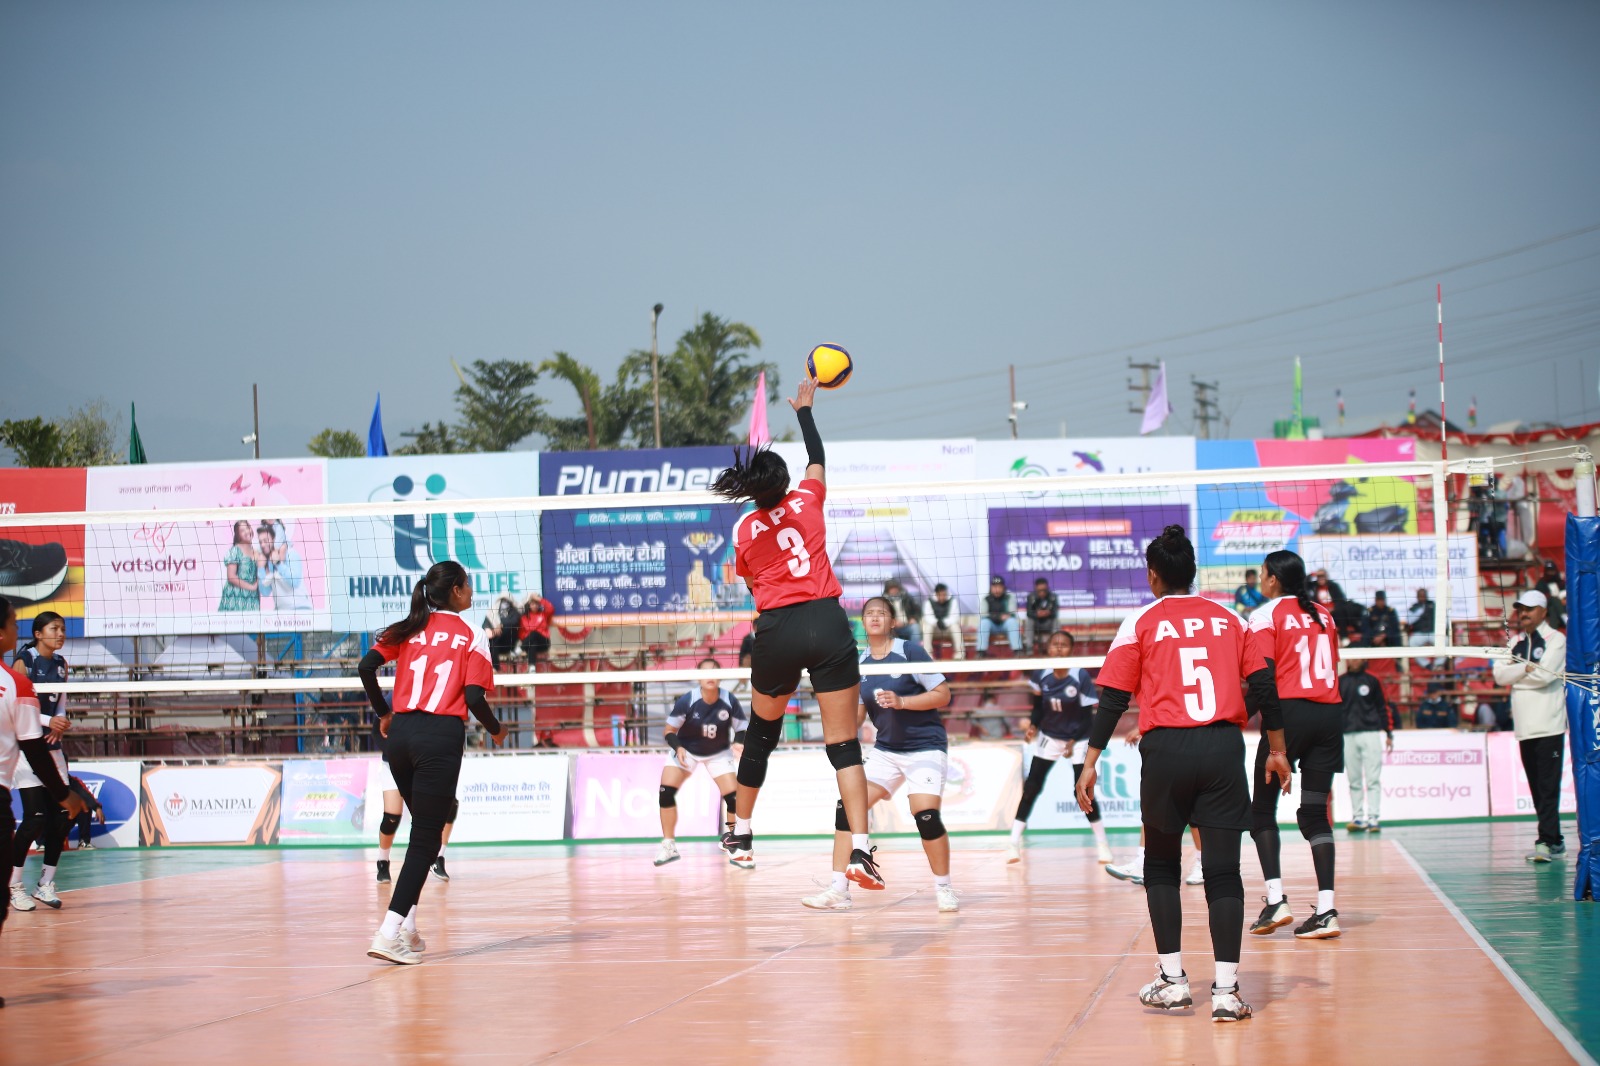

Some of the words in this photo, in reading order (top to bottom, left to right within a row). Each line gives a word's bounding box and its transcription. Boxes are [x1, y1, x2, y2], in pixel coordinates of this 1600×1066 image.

[942, 445, 973, 455] Ncell
[776, 527, 811, 577] 3
[1006, 540, 1066, 556] STUDY
[111, 554, 196, 575] vatsalya
[556, 564, 595, 575] PLUMBER
[597, 562, 621, 573] PIPES
[630, 560, 666, 572] FITTINGS
[1006, 555, 1083, 572] ABROAD
[1349, 568, 1398, 579] CITIZEN
[476, 572, 522, 594] LIFE
[1155, 617, 1229, 642] APF
[1295, 633, 1335, 689] 14
[406, 654, 454, 713] 11
[1179, 646, 1216, 722] 5
[1050, 697, 1062, 712] 11
[702, 724, 718, 739] 18
[485, 794, 512, 802] BIKASH
[1383, 782, 1472, 801] vatsalya
[191, 799, 256, 810] MANIPAL
